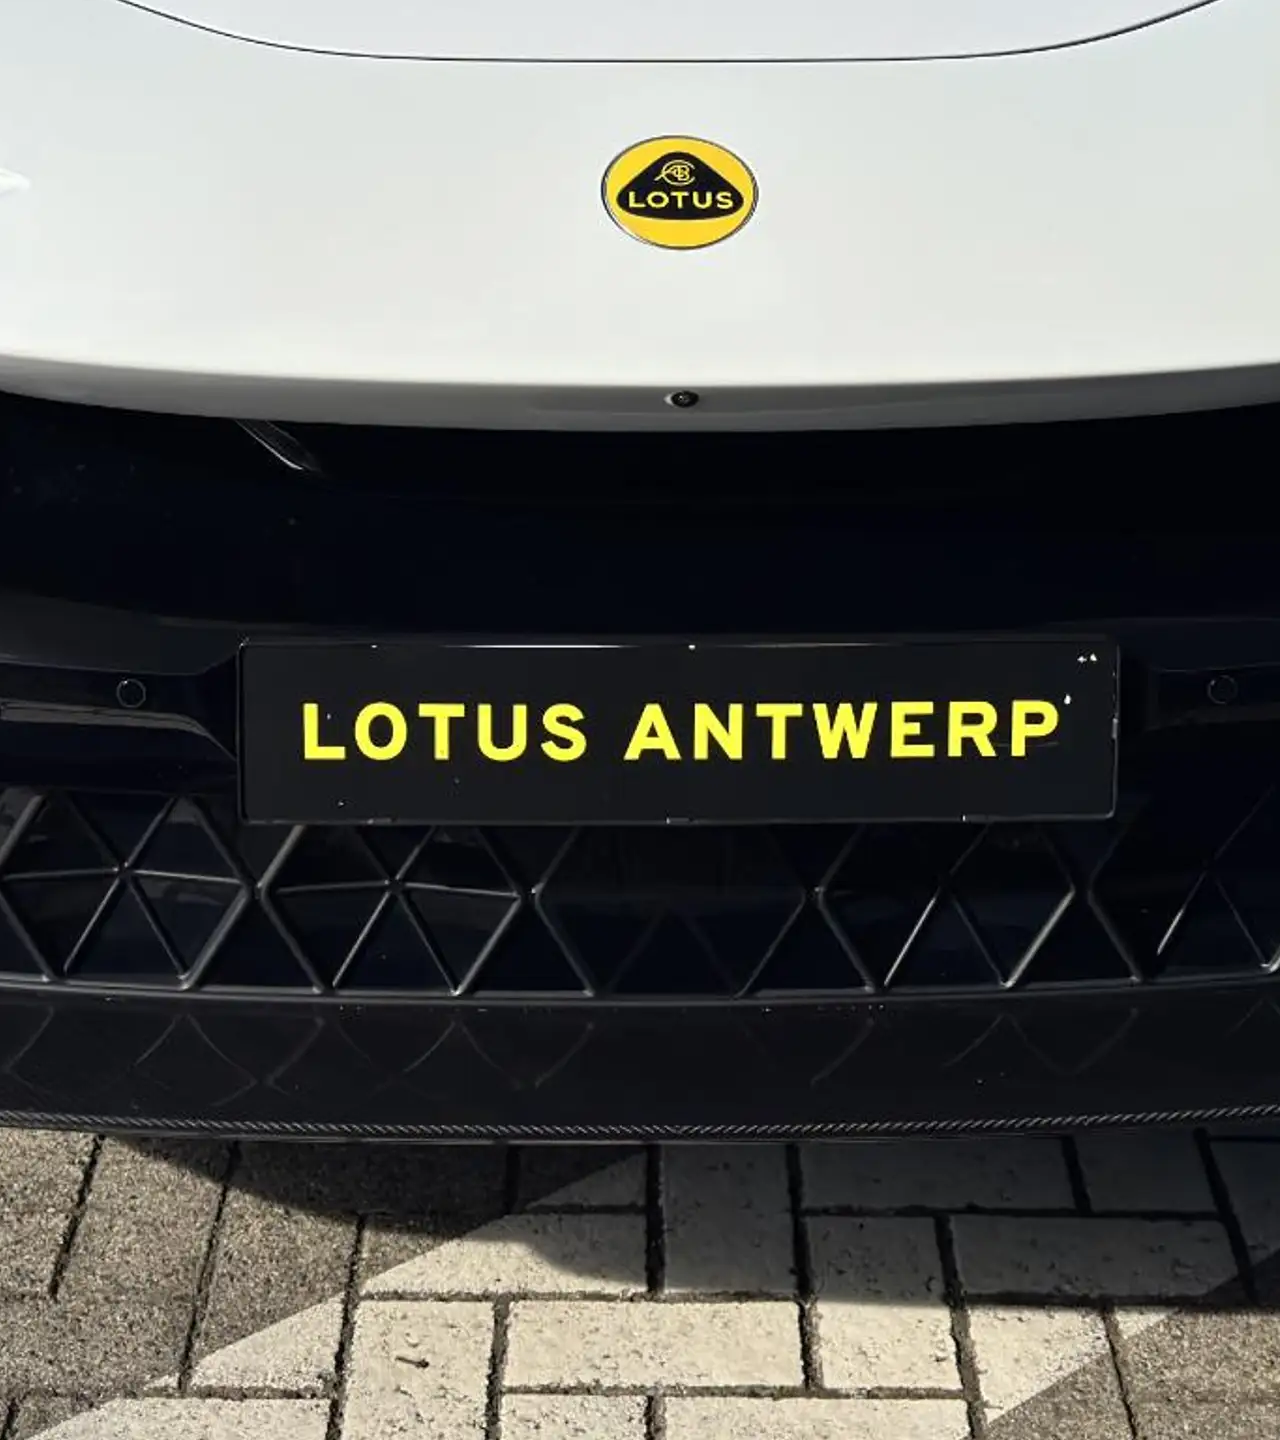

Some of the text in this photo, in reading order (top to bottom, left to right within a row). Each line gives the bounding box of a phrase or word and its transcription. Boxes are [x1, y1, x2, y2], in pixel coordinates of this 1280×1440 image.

[627, 190, 734, 210] LOTUS
[302, 699, 1060, 763] LOTUS ANTWERP
